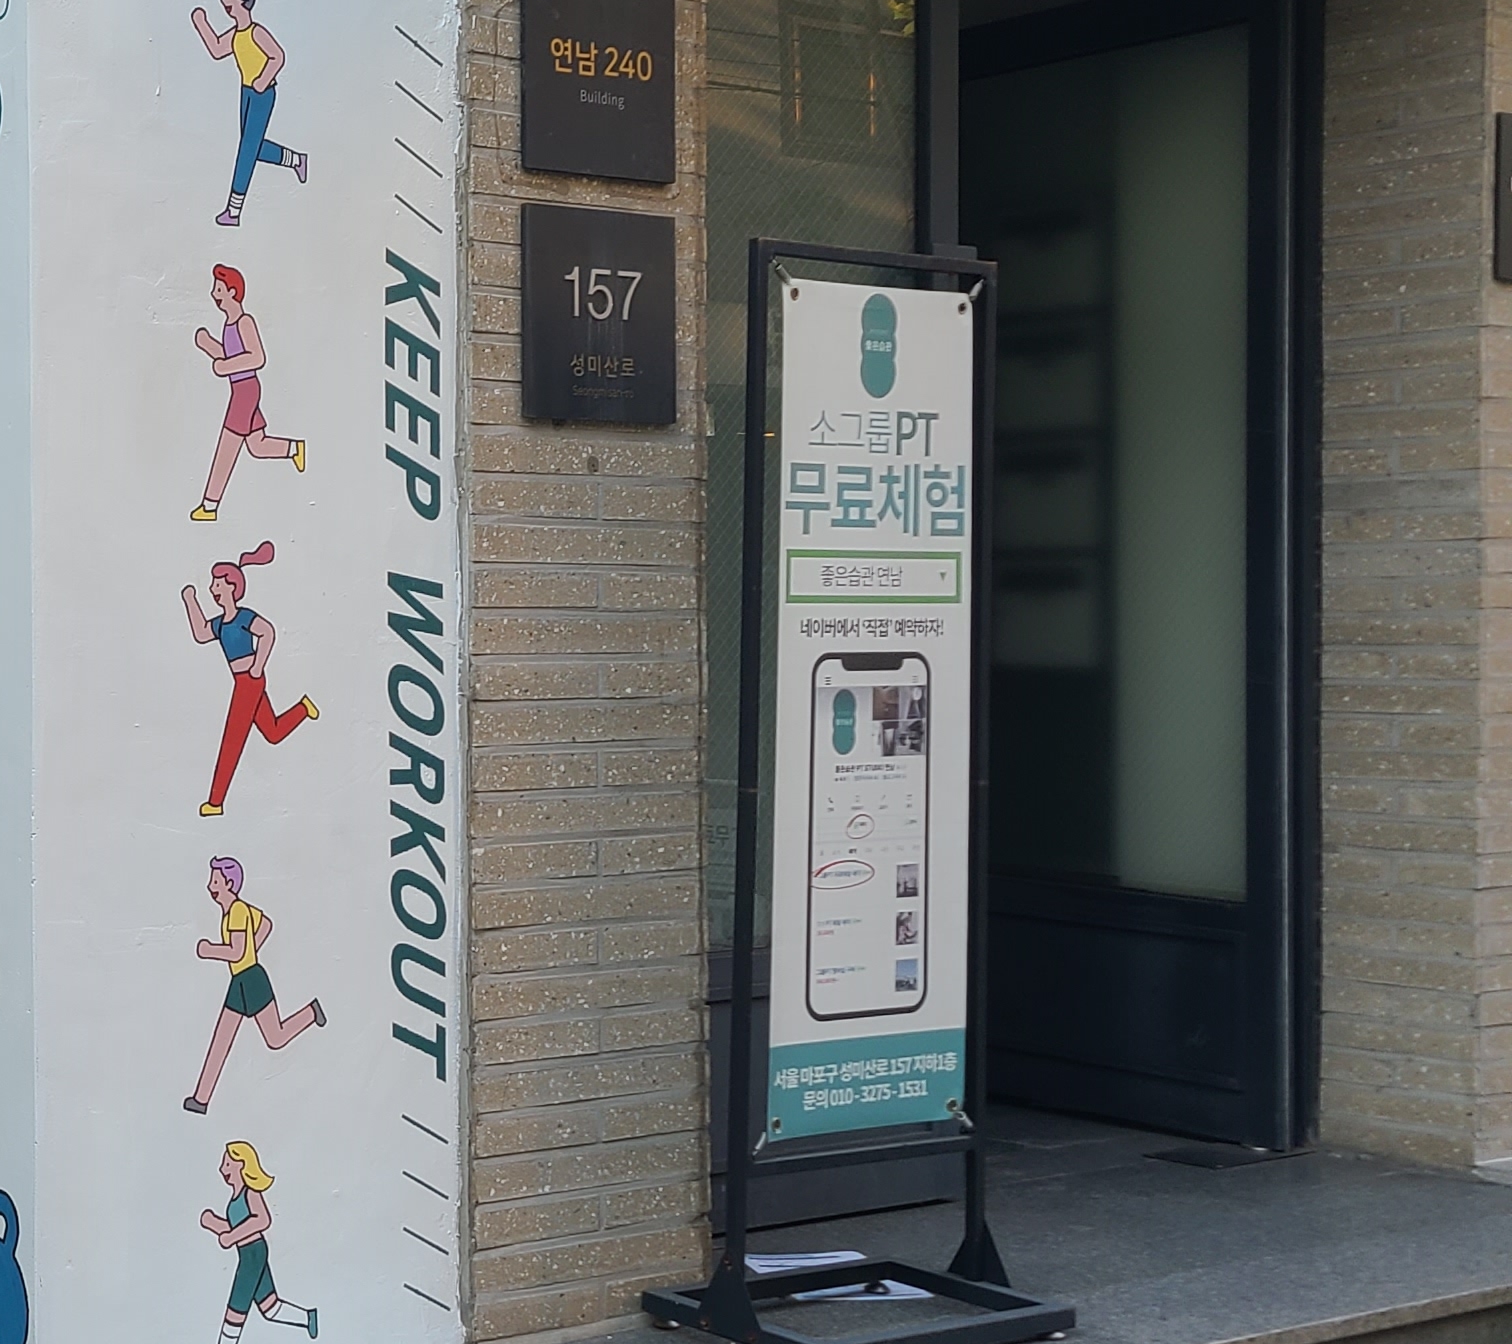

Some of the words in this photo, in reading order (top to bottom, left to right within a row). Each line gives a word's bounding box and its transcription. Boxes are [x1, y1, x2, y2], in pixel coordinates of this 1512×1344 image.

[550, 37, 599, 77] 연남
[604, 46, 653, 82] 240
[580, 89, 625, 111] Building
[563, 265, 644, 322] 157
[570, 353, 636, 378] 성미산로
[384, 247, 441, 522] KEEP
[785, 462, 966, 537] 무료체험
[820, 565, 875, 588] 좋은습관
[800, 618, 861, 638] 네이버에서
[386, 571, 447, 1083] WORKOUT
[774, 1067, 800, 1090] 서울
[800, 1063, 838, 1086] 마포구
[839, 1058, 889, 1082] 성미산로
[890, 1057, 912, 1076] 157
[802, 1088, 829, 1111] 문의
